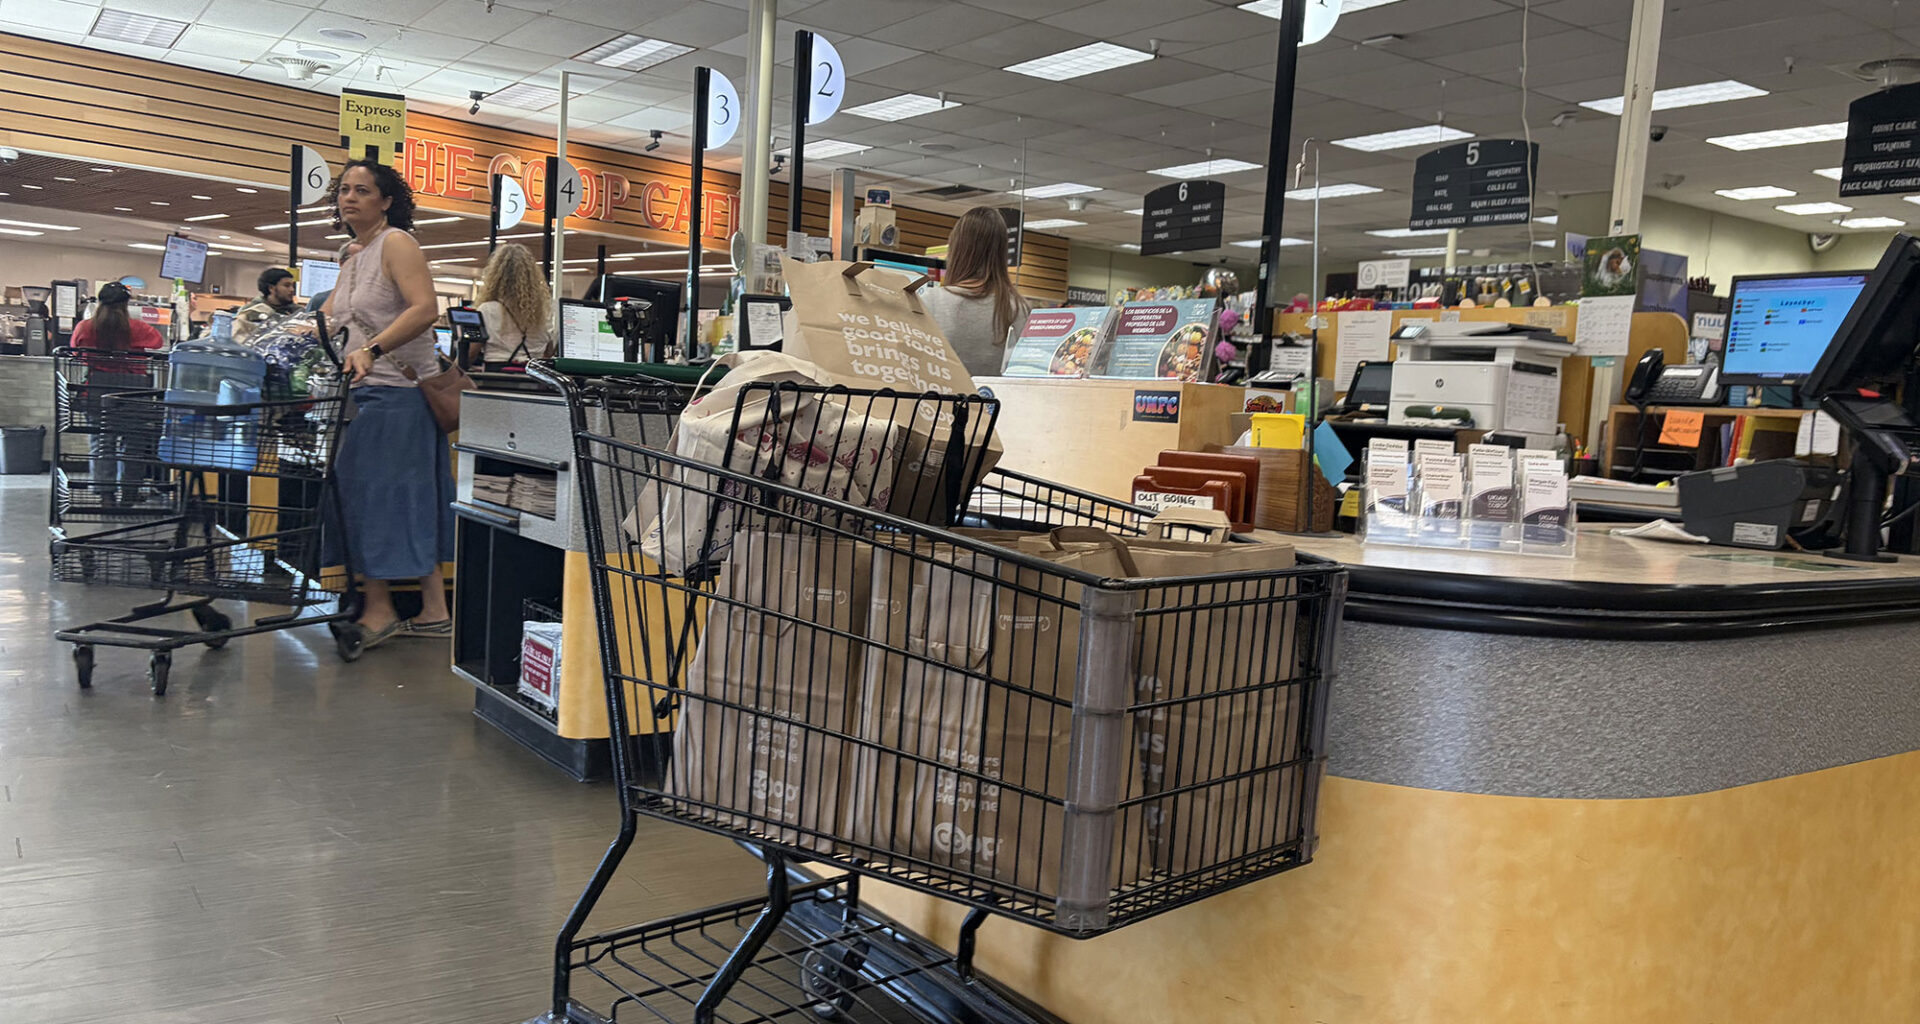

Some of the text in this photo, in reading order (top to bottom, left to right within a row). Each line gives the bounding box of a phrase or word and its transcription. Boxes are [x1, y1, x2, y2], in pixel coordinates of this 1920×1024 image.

[817, 62, 835, 97] 2
[345, 100, 402, 118] Express
[713, 94, 730, 125] 3
[355, 119, 391, 134] Lane
[1895, 121, 1917, 131] CARE
[1466, 141, 1480, 165] 5
[1873, 141, 1911, 151] VITAMINS
[307, 165, 323, 189] 6
[402, 136, 475, 200] HE
[560, 177, 575, 204] 4
[1178, 182, 1188, 201] 6
[505, 193, 519, 213] 5
[1068, 289, 1106, 303] ESTROOMS
[838, 312, 943, 347] we believe
[842, 326, 947, 362] good food
[847, 342, 952, 382] brings us
[1138, 493, 1196, 506] OUT GOING
